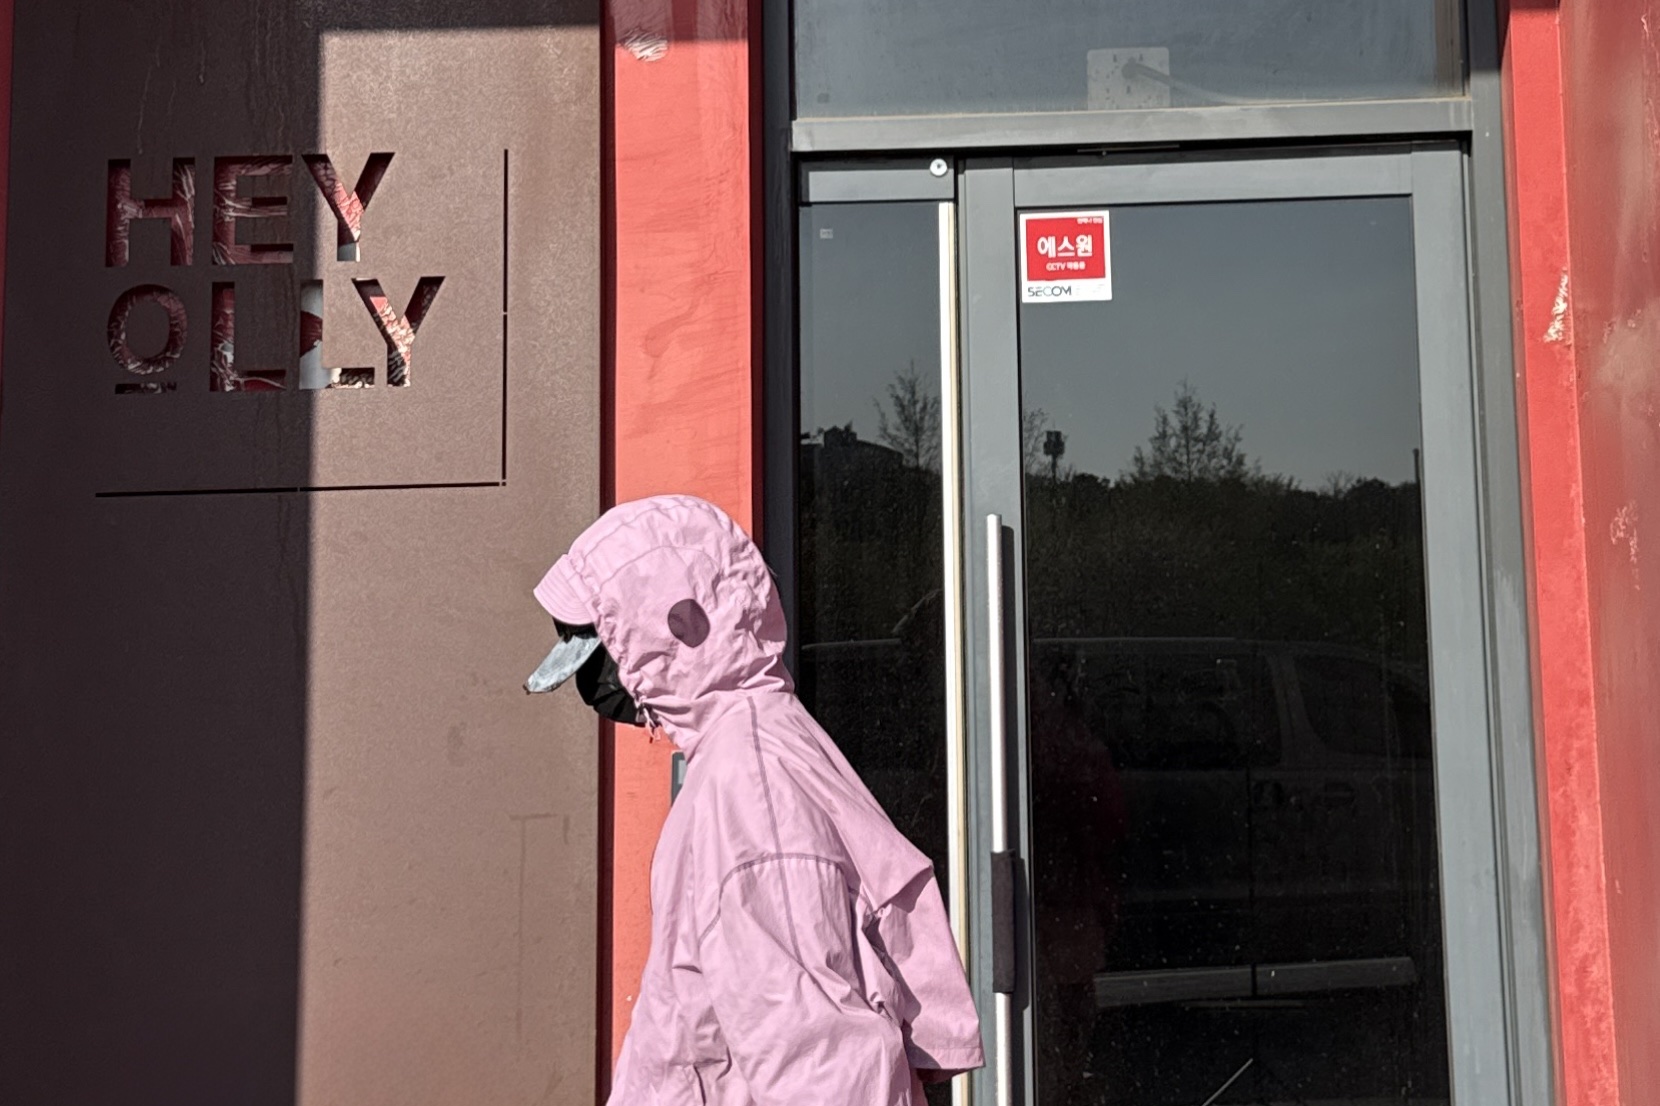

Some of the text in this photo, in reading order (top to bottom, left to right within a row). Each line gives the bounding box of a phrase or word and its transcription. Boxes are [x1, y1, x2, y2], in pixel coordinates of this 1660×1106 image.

[105, 152, 395, 268] HEY
[1037, 234, 1093, 258] 에스원
[1046, 262, 1066, 271] CCTV
[1027, 285, 1072, 297] SECOM
[106, 276, 446, 394] OLLY
